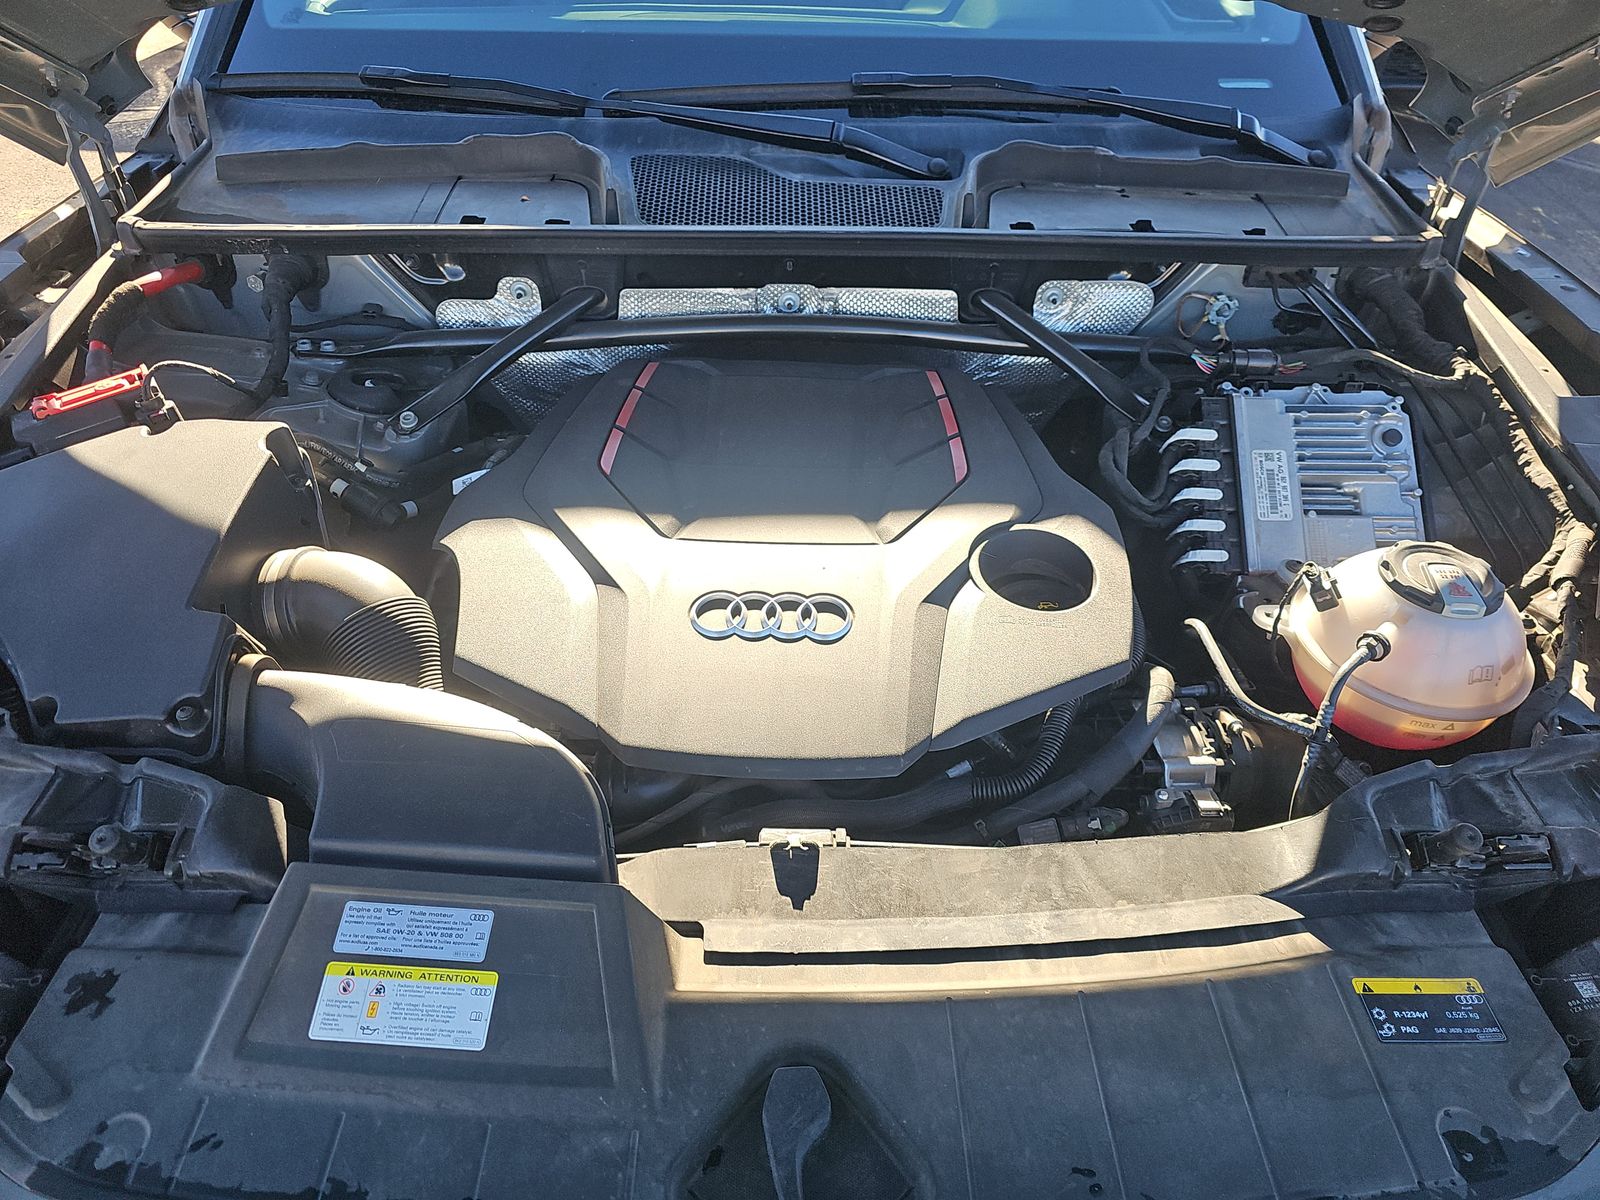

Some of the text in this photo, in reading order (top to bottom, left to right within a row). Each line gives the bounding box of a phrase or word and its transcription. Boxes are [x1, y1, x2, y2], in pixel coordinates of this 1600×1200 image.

[1409, 720, 1436, 729] max
[360, 968, 479, 983] WARNING ATTENTION
[1393, 1011, 1429, 1019] R-1234yf
